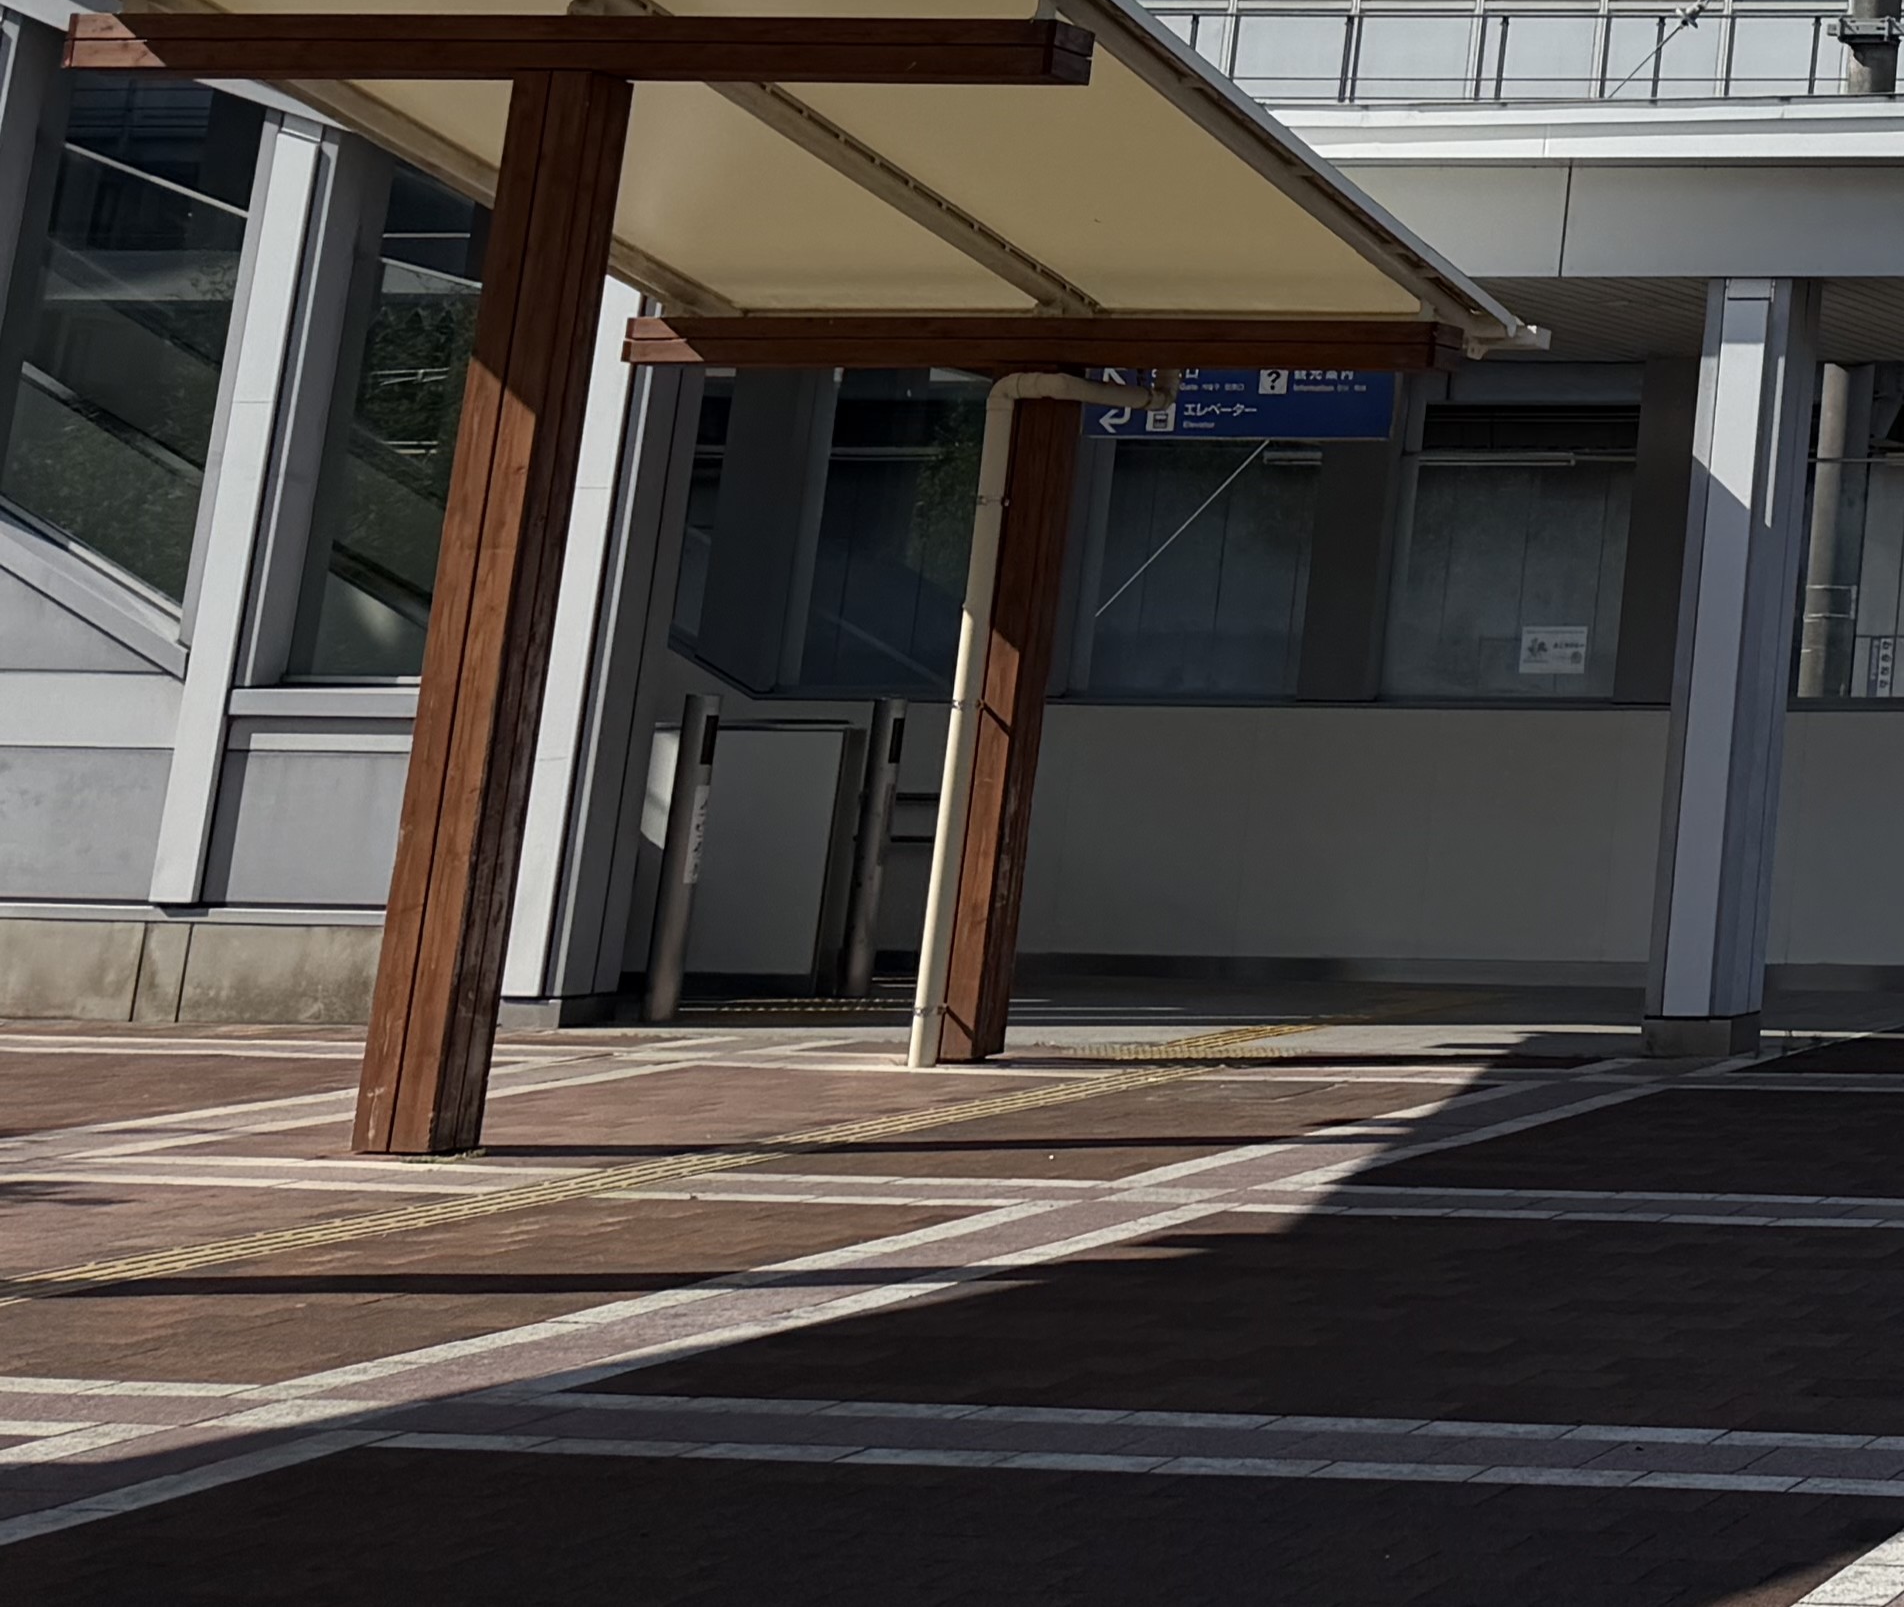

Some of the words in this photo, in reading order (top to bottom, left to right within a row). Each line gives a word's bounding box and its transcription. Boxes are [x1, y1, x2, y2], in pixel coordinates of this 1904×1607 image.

[1183, 403, 1257, 417] エレベーター
